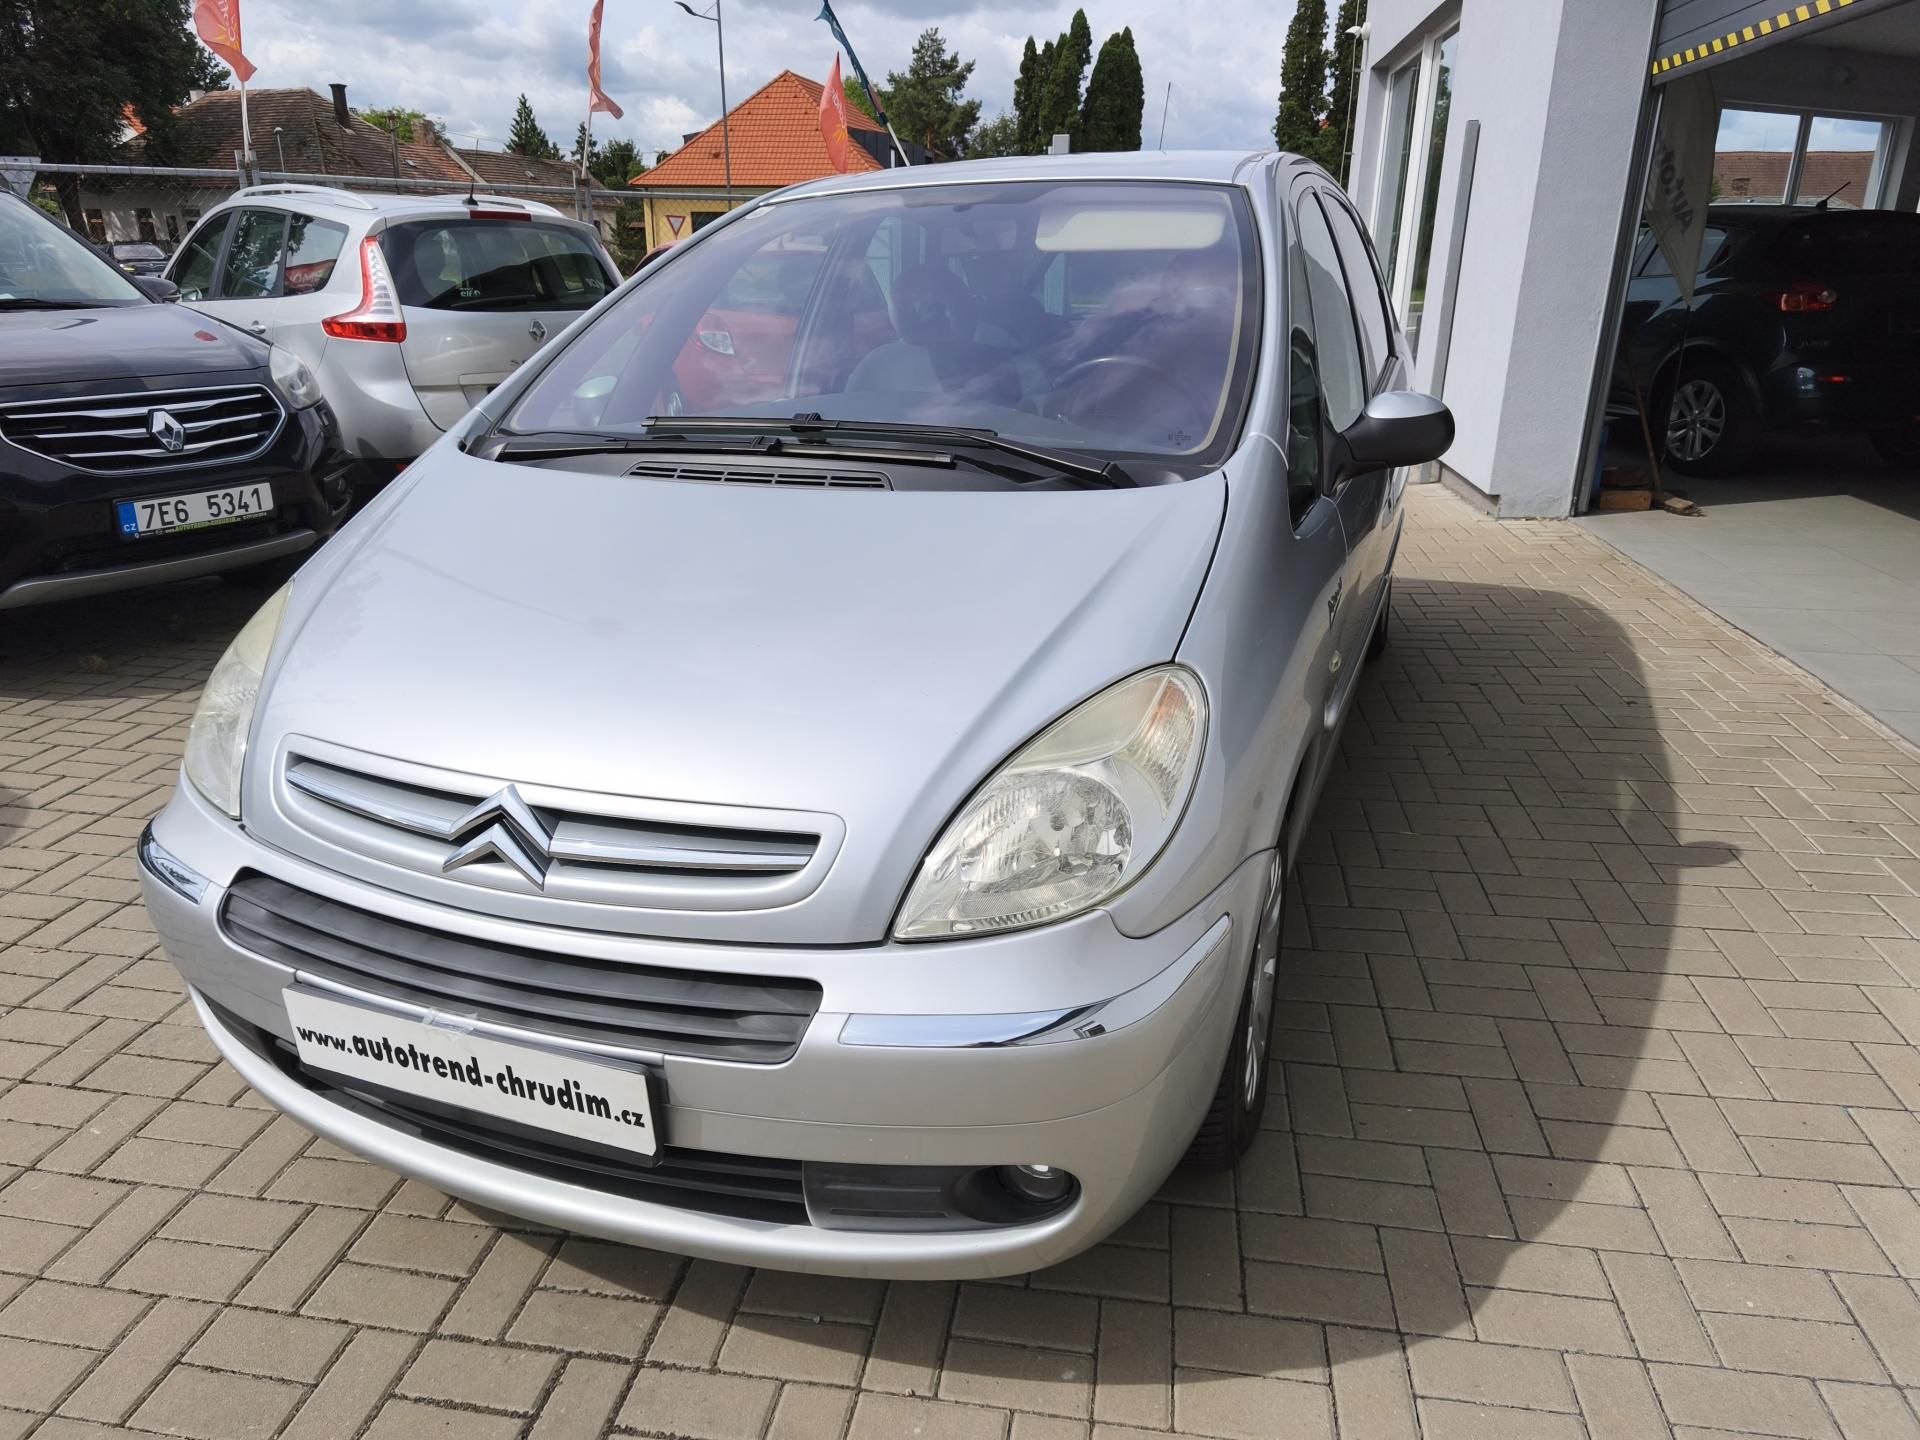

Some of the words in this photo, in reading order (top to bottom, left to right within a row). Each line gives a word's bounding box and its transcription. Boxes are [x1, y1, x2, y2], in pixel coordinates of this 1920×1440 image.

[123, 523, 137, 532] CZ
[141, 499, 189, 530] 7E6
[206, 487, 263, 518] 5341
[296, 1025, 645, 1128] www.autotrend-chrudim.cz
